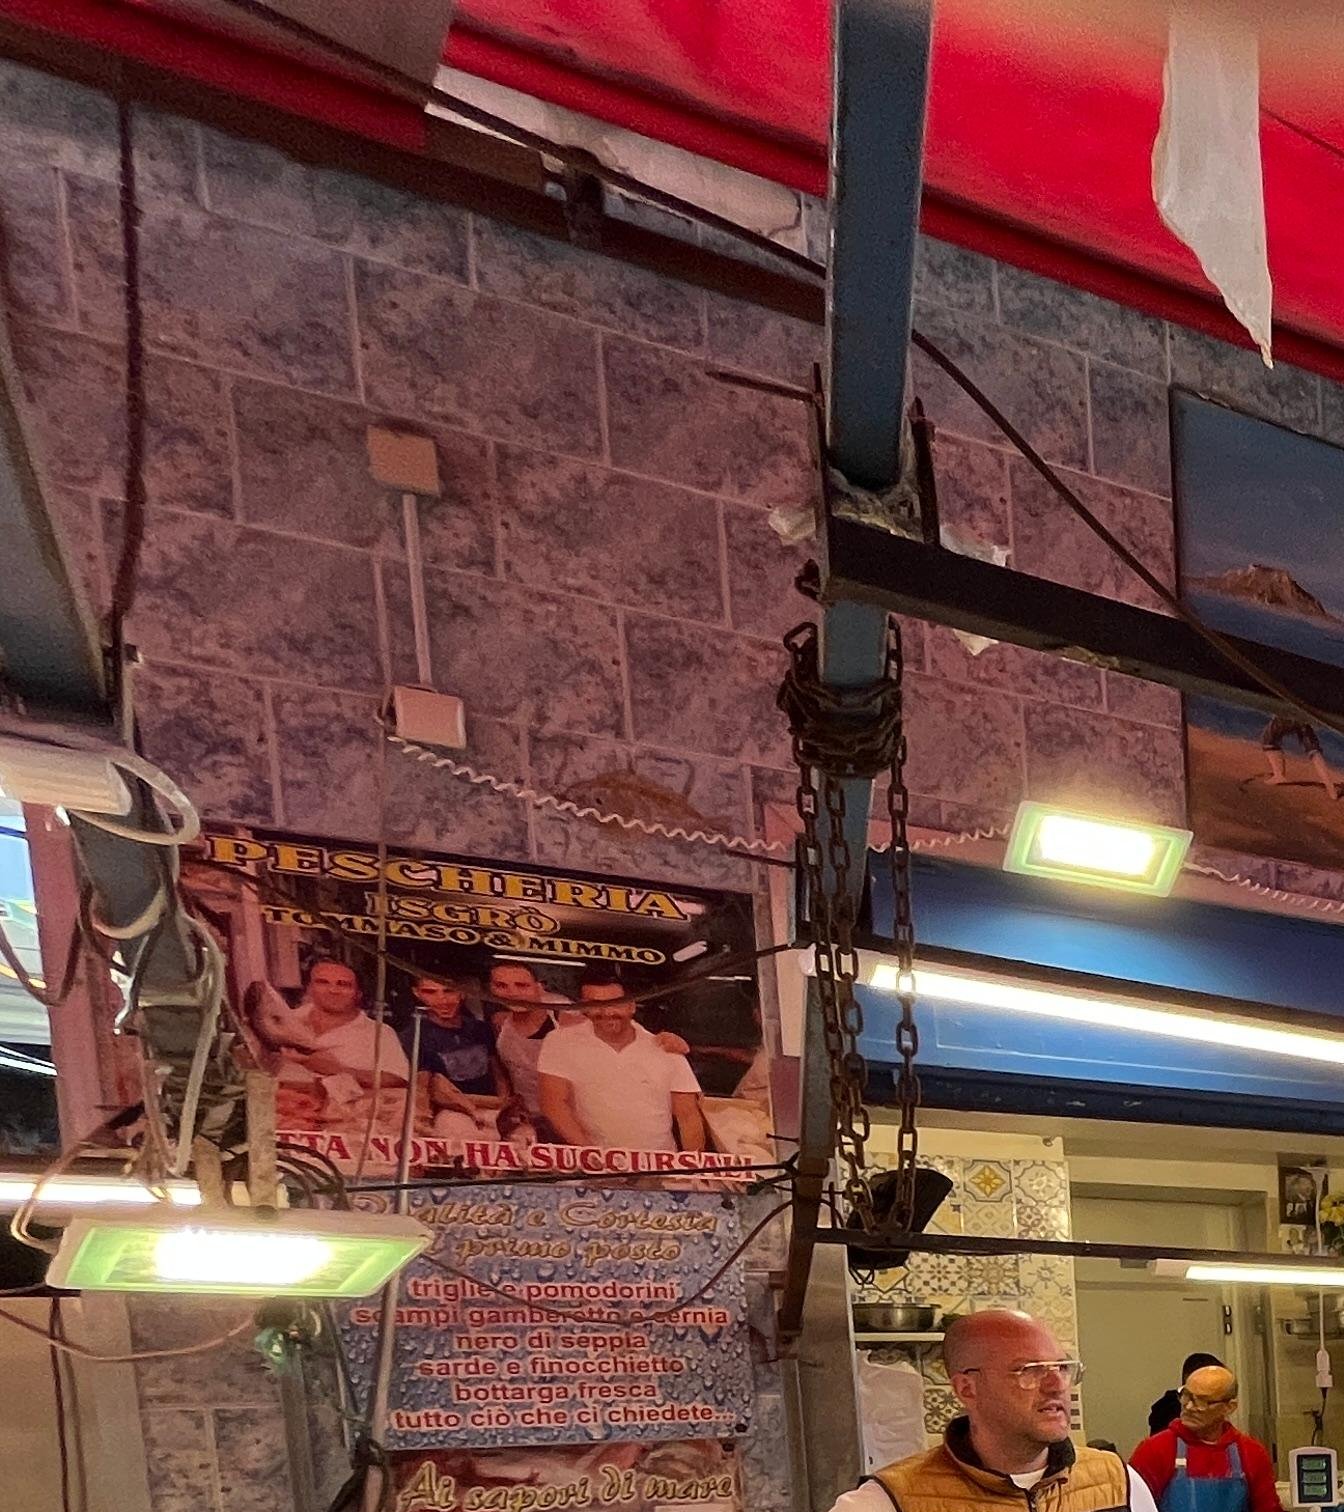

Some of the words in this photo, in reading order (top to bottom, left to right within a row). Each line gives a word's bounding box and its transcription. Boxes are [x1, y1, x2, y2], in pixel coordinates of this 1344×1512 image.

[205, 833, 690, 920] PESCHERIA
[365, 891, 560, 935] ISGRÒ
[528, 936, 666, 966] MIMMO
[276, 1132, 352, 1160] TTA
[366, 1137, 452, 1166] NON
[462, 1142, 522, 1170] HA
[530, 1145, 755, 1179] SUCCURSALI
[527, 1209, 546, 1227] e
[559, 1201, 718, 1232] Cortesia
[456, 1235, 571, 1266] primo
[584, 1238, 681, 1268] posto
[411, 1280, 498, 1302] triglie
[527, 1281, 676, 1302] pomodorini
[630, 1310, 643, 1323] e
[456, 1335, 518, 1350] nero
[528, 1330, 551, 1350] di
[561, 1333, 646, 1352] seppia
[418, 1358, 497, 1376] sarde
[507, 1361, 521, 1375] e
[530, 1357, 685, 1376] finocchietto
[455, 1382, 568, 1404] bottarga
[578, 1381, 657, 1399] fresca
[394, 1411, 459, 1430] tutto
[470, 1408, 508, 1427] ciò
[521, 1407, 567, 1426] che
[576, 1406, 599, 1424] ci
[608, 1405, 735, 1424] chiedete...
[600, 1465, 637, 1503] di
[645, 1475, 734, 1500] mare
